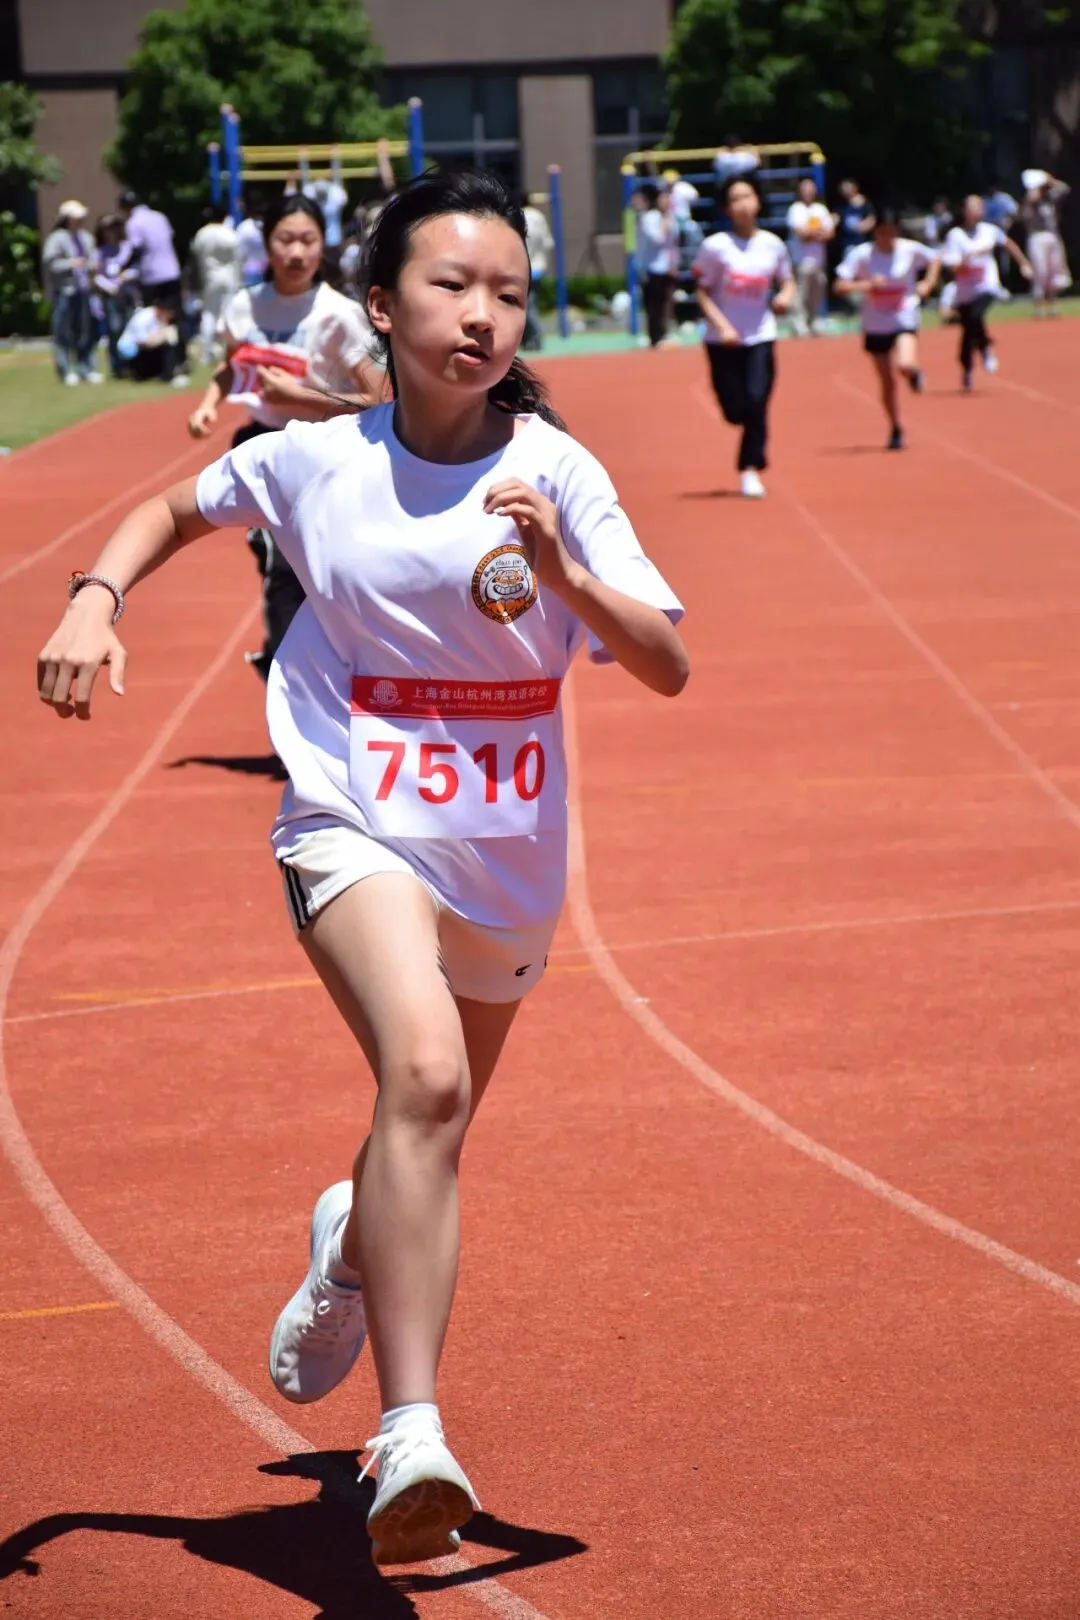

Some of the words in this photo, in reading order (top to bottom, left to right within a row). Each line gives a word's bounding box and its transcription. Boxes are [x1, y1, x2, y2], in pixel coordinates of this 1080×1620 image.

[412, 685, 548, 702] 上海金山杭州湾双语学校
[367, 740, 546, 804] 7510
